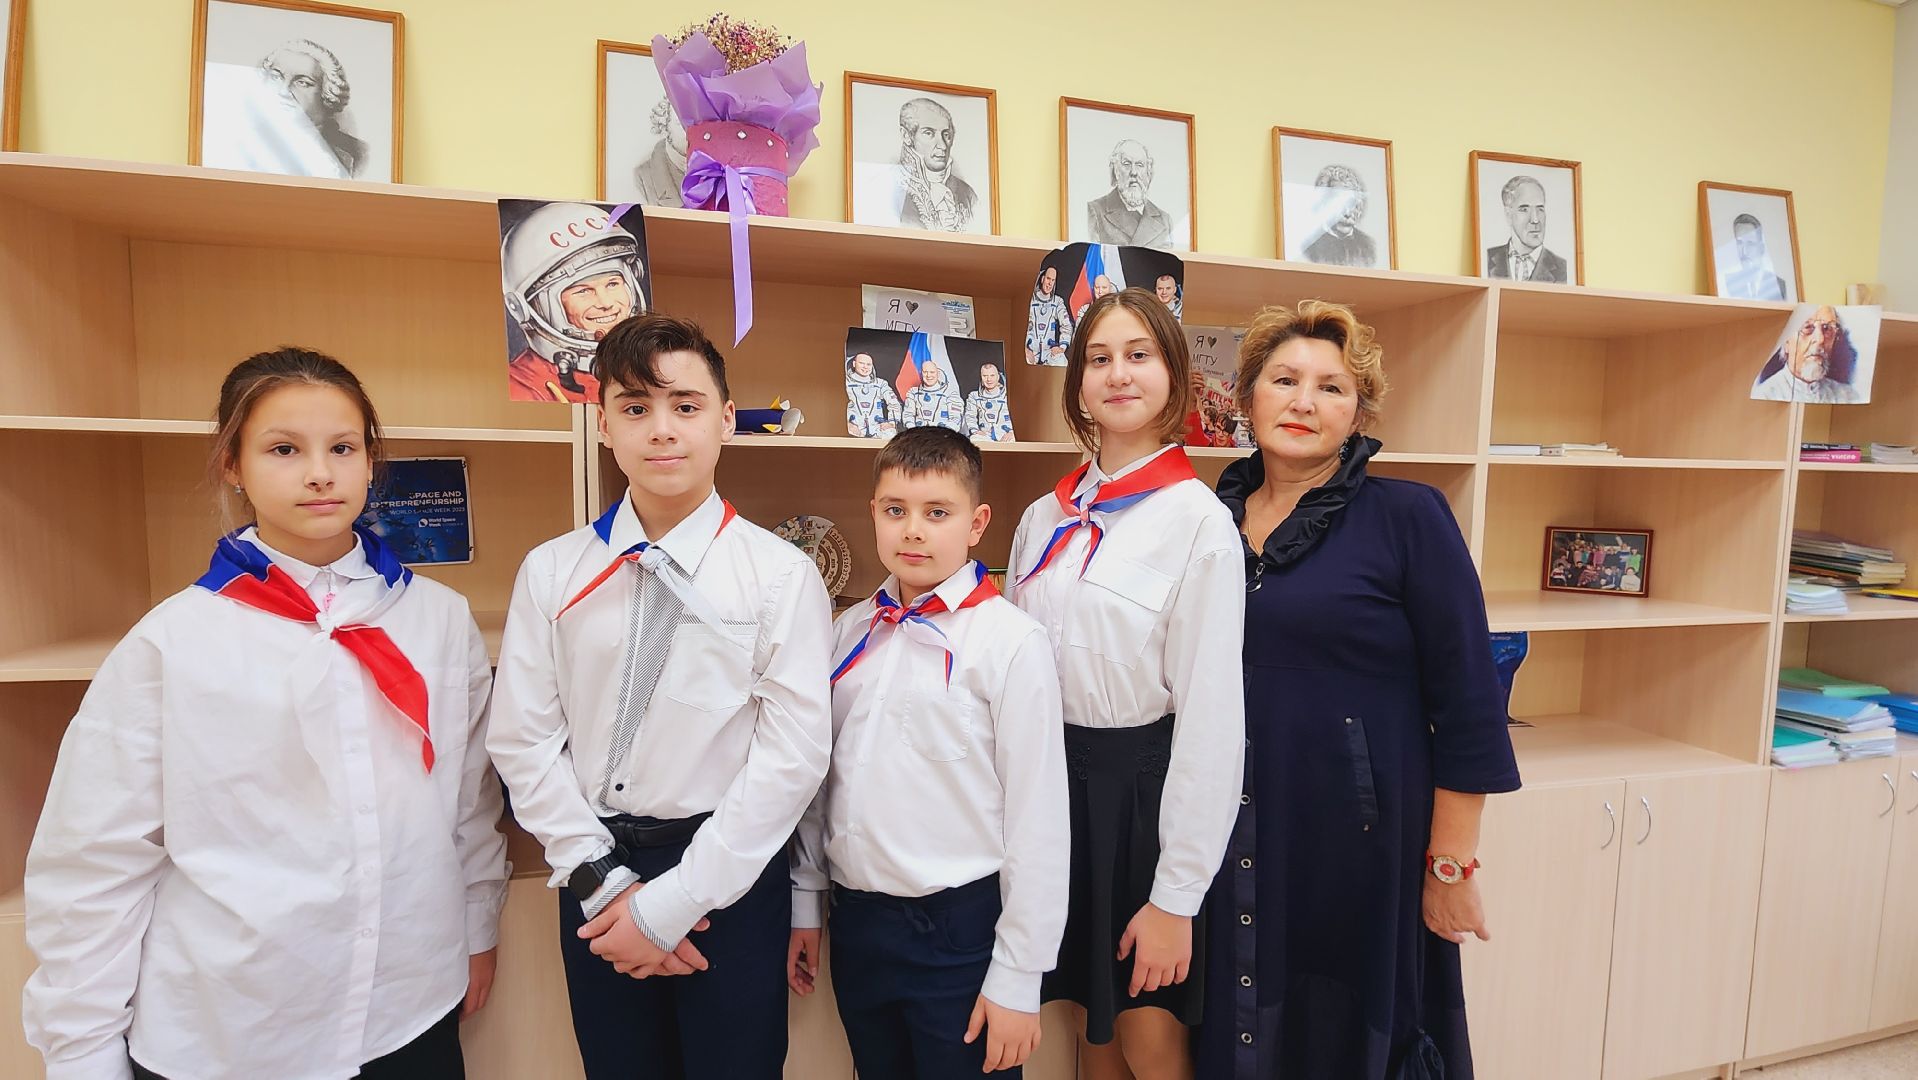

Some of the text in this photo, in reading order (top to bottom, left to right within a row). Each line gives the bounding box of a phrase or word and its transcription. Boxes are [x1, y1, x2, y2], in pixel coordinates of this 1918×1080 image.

[888, 298, 900, 313] Я
[1195, 336, 1205, 348] Я
[1192, 353, 1218, 366] МГТУ
[442, 490, 462, 498] AND
